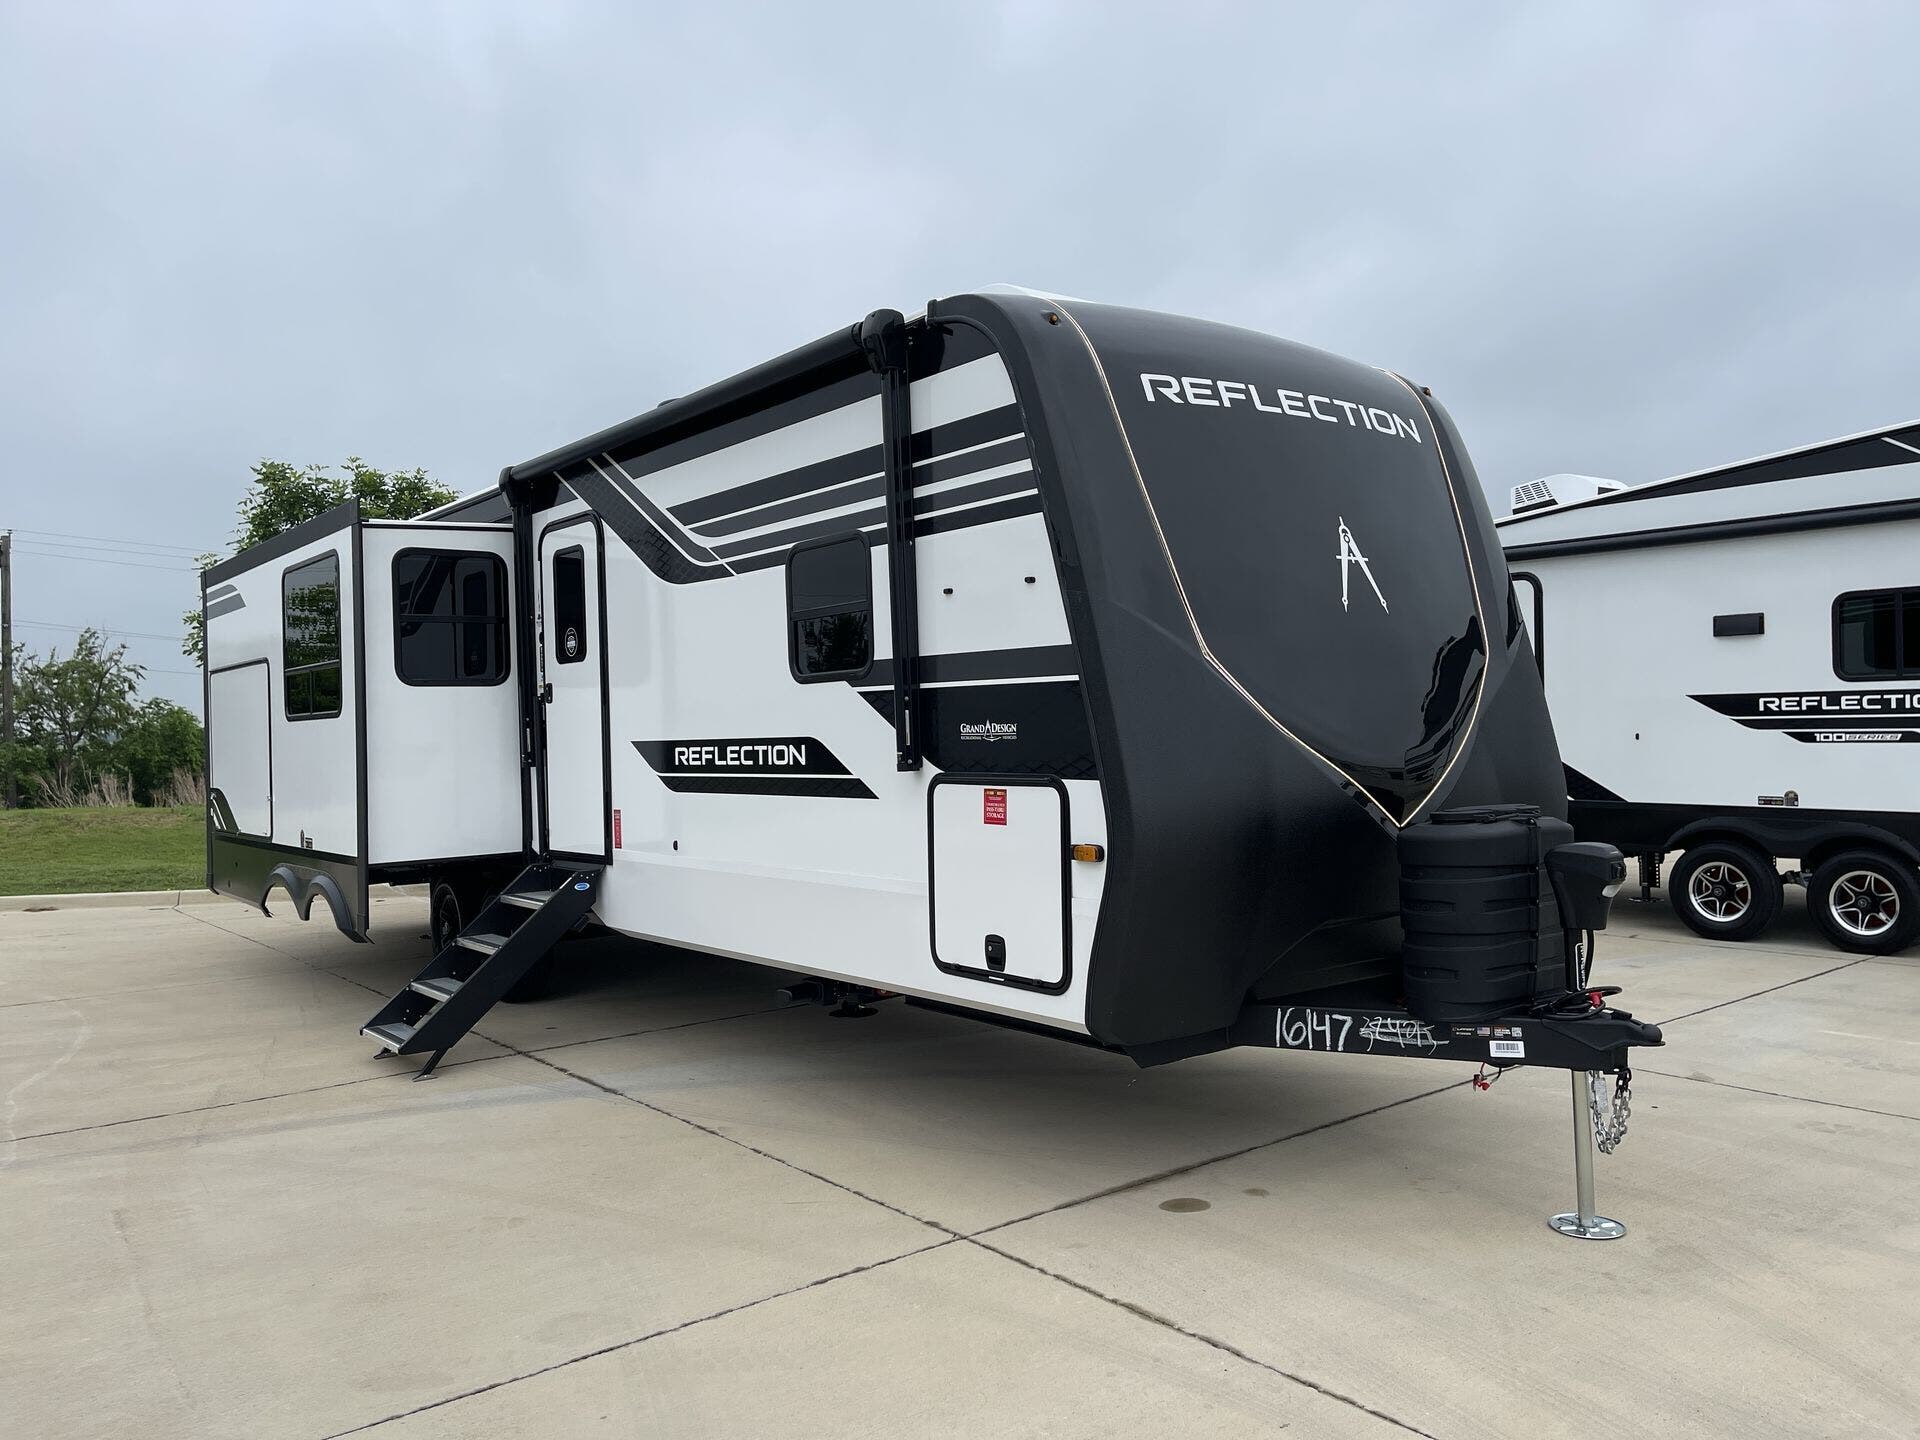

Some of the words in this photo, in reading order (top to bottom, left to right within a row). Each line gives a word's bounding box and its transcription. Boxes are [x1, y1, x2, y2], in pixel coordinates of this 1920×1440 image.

[1140, 373, 1422, 444] REFLECTION
[960, 723, 985, 733] GRAND
[991, 722, 1017, 733] DESIGN
[1814, 733, 1845, 741] 100
[674, 744, 806, 766] REFLECTION
[1276, 1007, 1353, 1051] 16147
